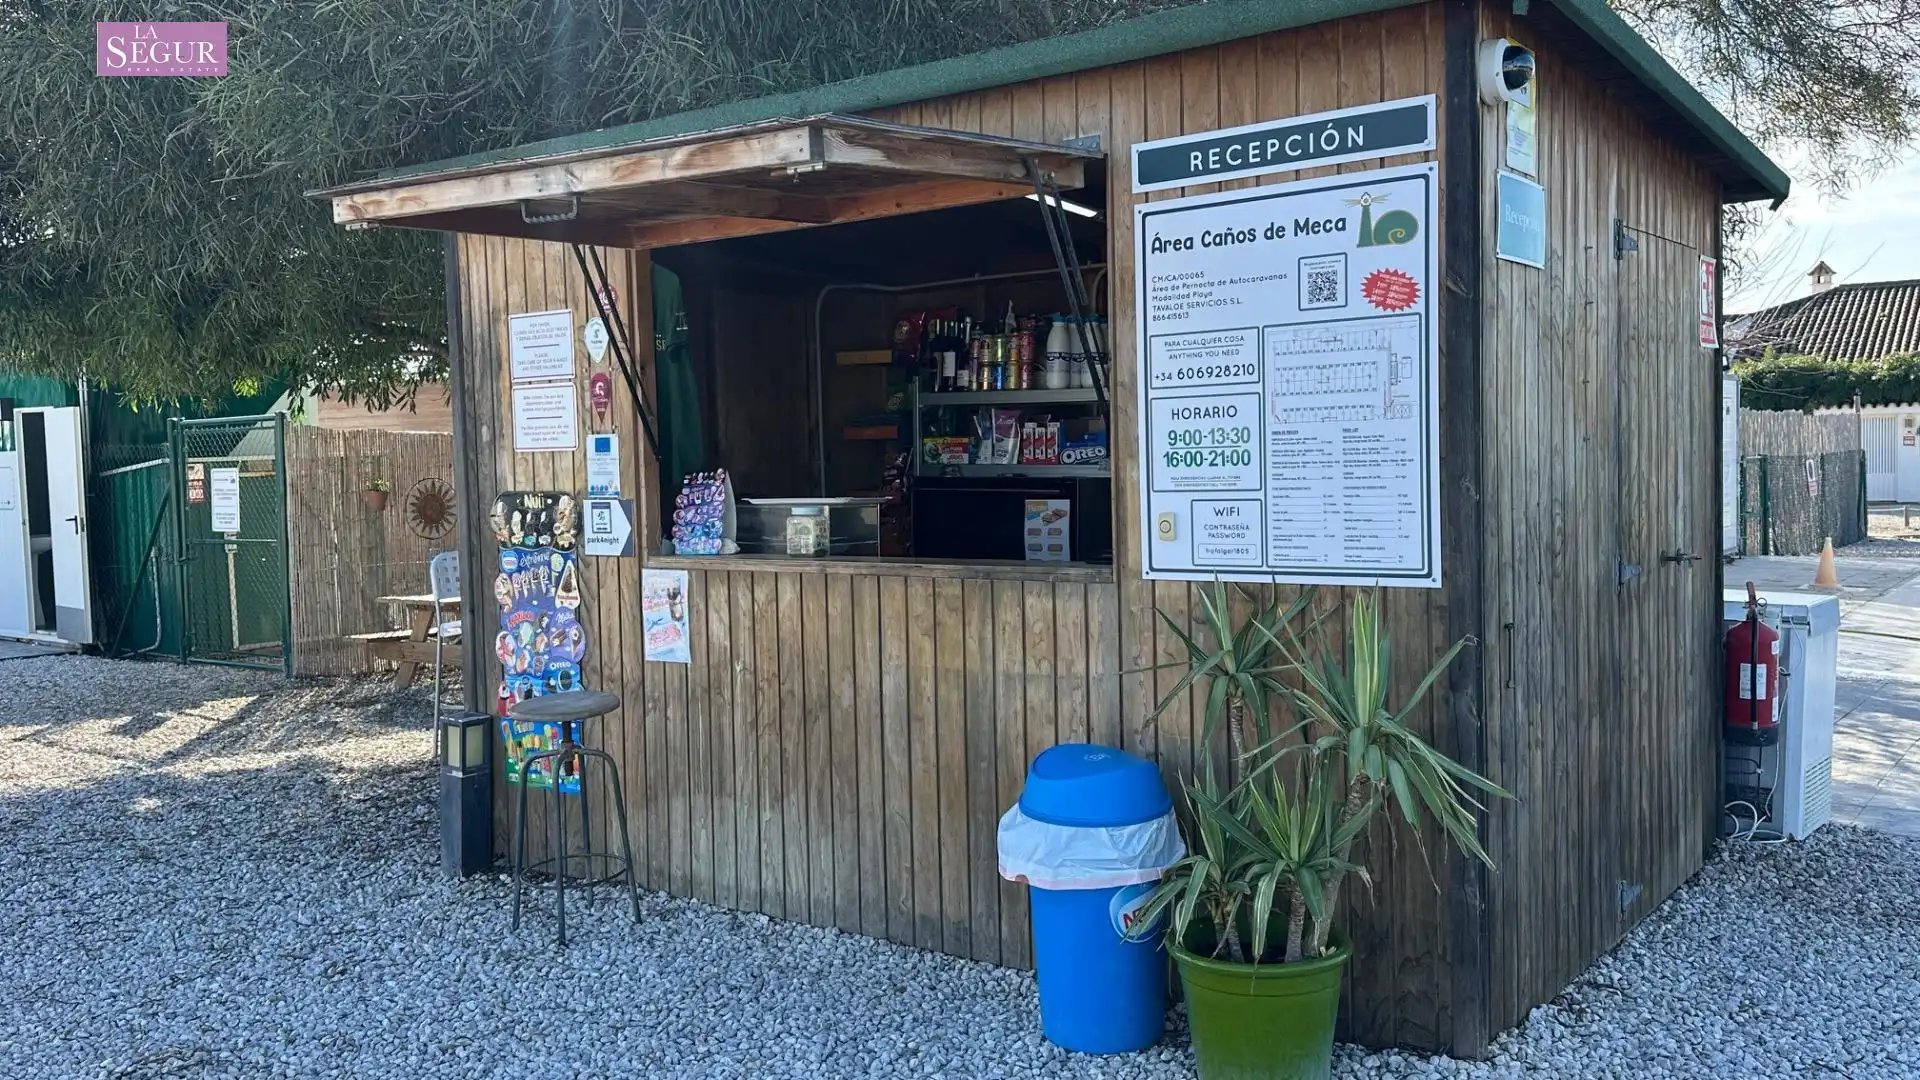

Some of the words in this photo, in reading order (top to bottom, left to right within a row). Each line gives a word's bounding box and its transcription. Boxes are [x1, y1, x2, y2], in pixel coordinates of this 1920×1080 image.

[1190, 122, 1365, 171] RECEPCIÓN
[1151, 232, 1194, 254] Área
[1201, 227, 1257, 248] Caños
[1263, 221, 1286, 241] de
[1293, 216, 1347, 238] Meca
[1151, 270, 1205, 284] CM/CA/00065
[1182, 280, 1215, 290] Pernocta
[1216, 278, 1226, 287] de
[1229, 272, 1288, 285] Autocaravanas
[1186, 298, 1228, 309] SERVICIOS
[1164, 340, 1181, 348] PARA
[1182, 337, 1222, 347] CUALQUIER
[1223, 335, 1245, 343] COSA
[1168, 351, 1203, 360] ANYTHING
[1221, 348, 1240, 356] NEED
[1154, 372, 1173, 381] +34
[1177, 363, 1255, 380] 606928210
[1171, 405, 1238, 420] HORARIO
[1167, 426, 1251, 446] 9:00-13:30
[1061, 447, 1105, 464] OREO
[1163, 449, 1252, 468] 16:00-21:00
[1213, 506, 1240, 517] WIFI
[1203, 522, 1250, 531] CONTRASEÑA
[586, 536, 620, 546] park4night
[1207, 531, 1246, 539] PASSWORD
